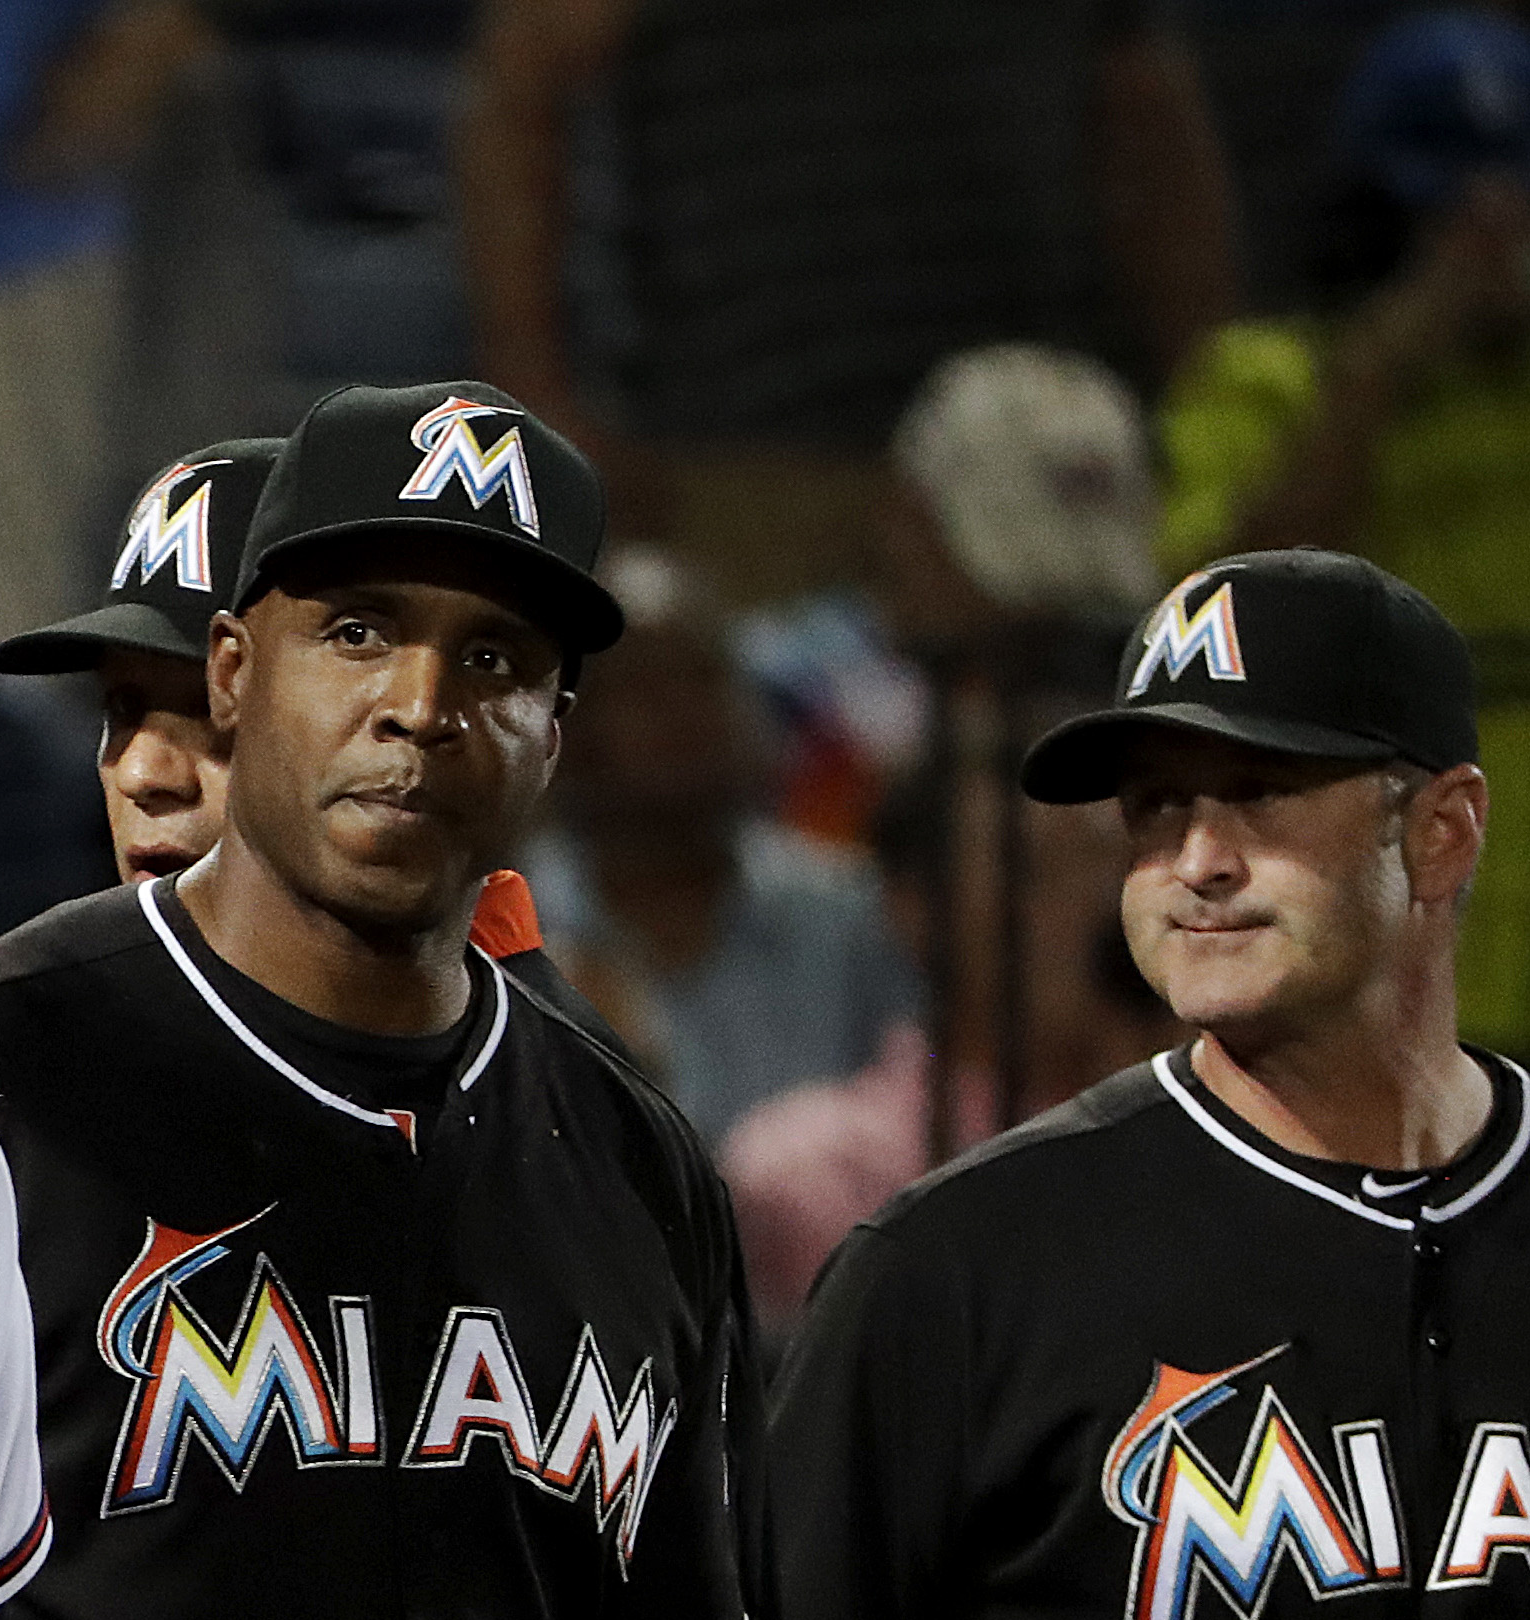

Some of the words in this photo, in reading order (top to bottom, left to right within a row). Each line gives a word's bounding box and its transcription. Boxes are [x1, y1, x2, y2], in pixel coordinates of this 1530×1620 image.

[399, 406, 541, 539] M
[110, 475, 213, 593] M
[1126, 580, 1248, 701] M
